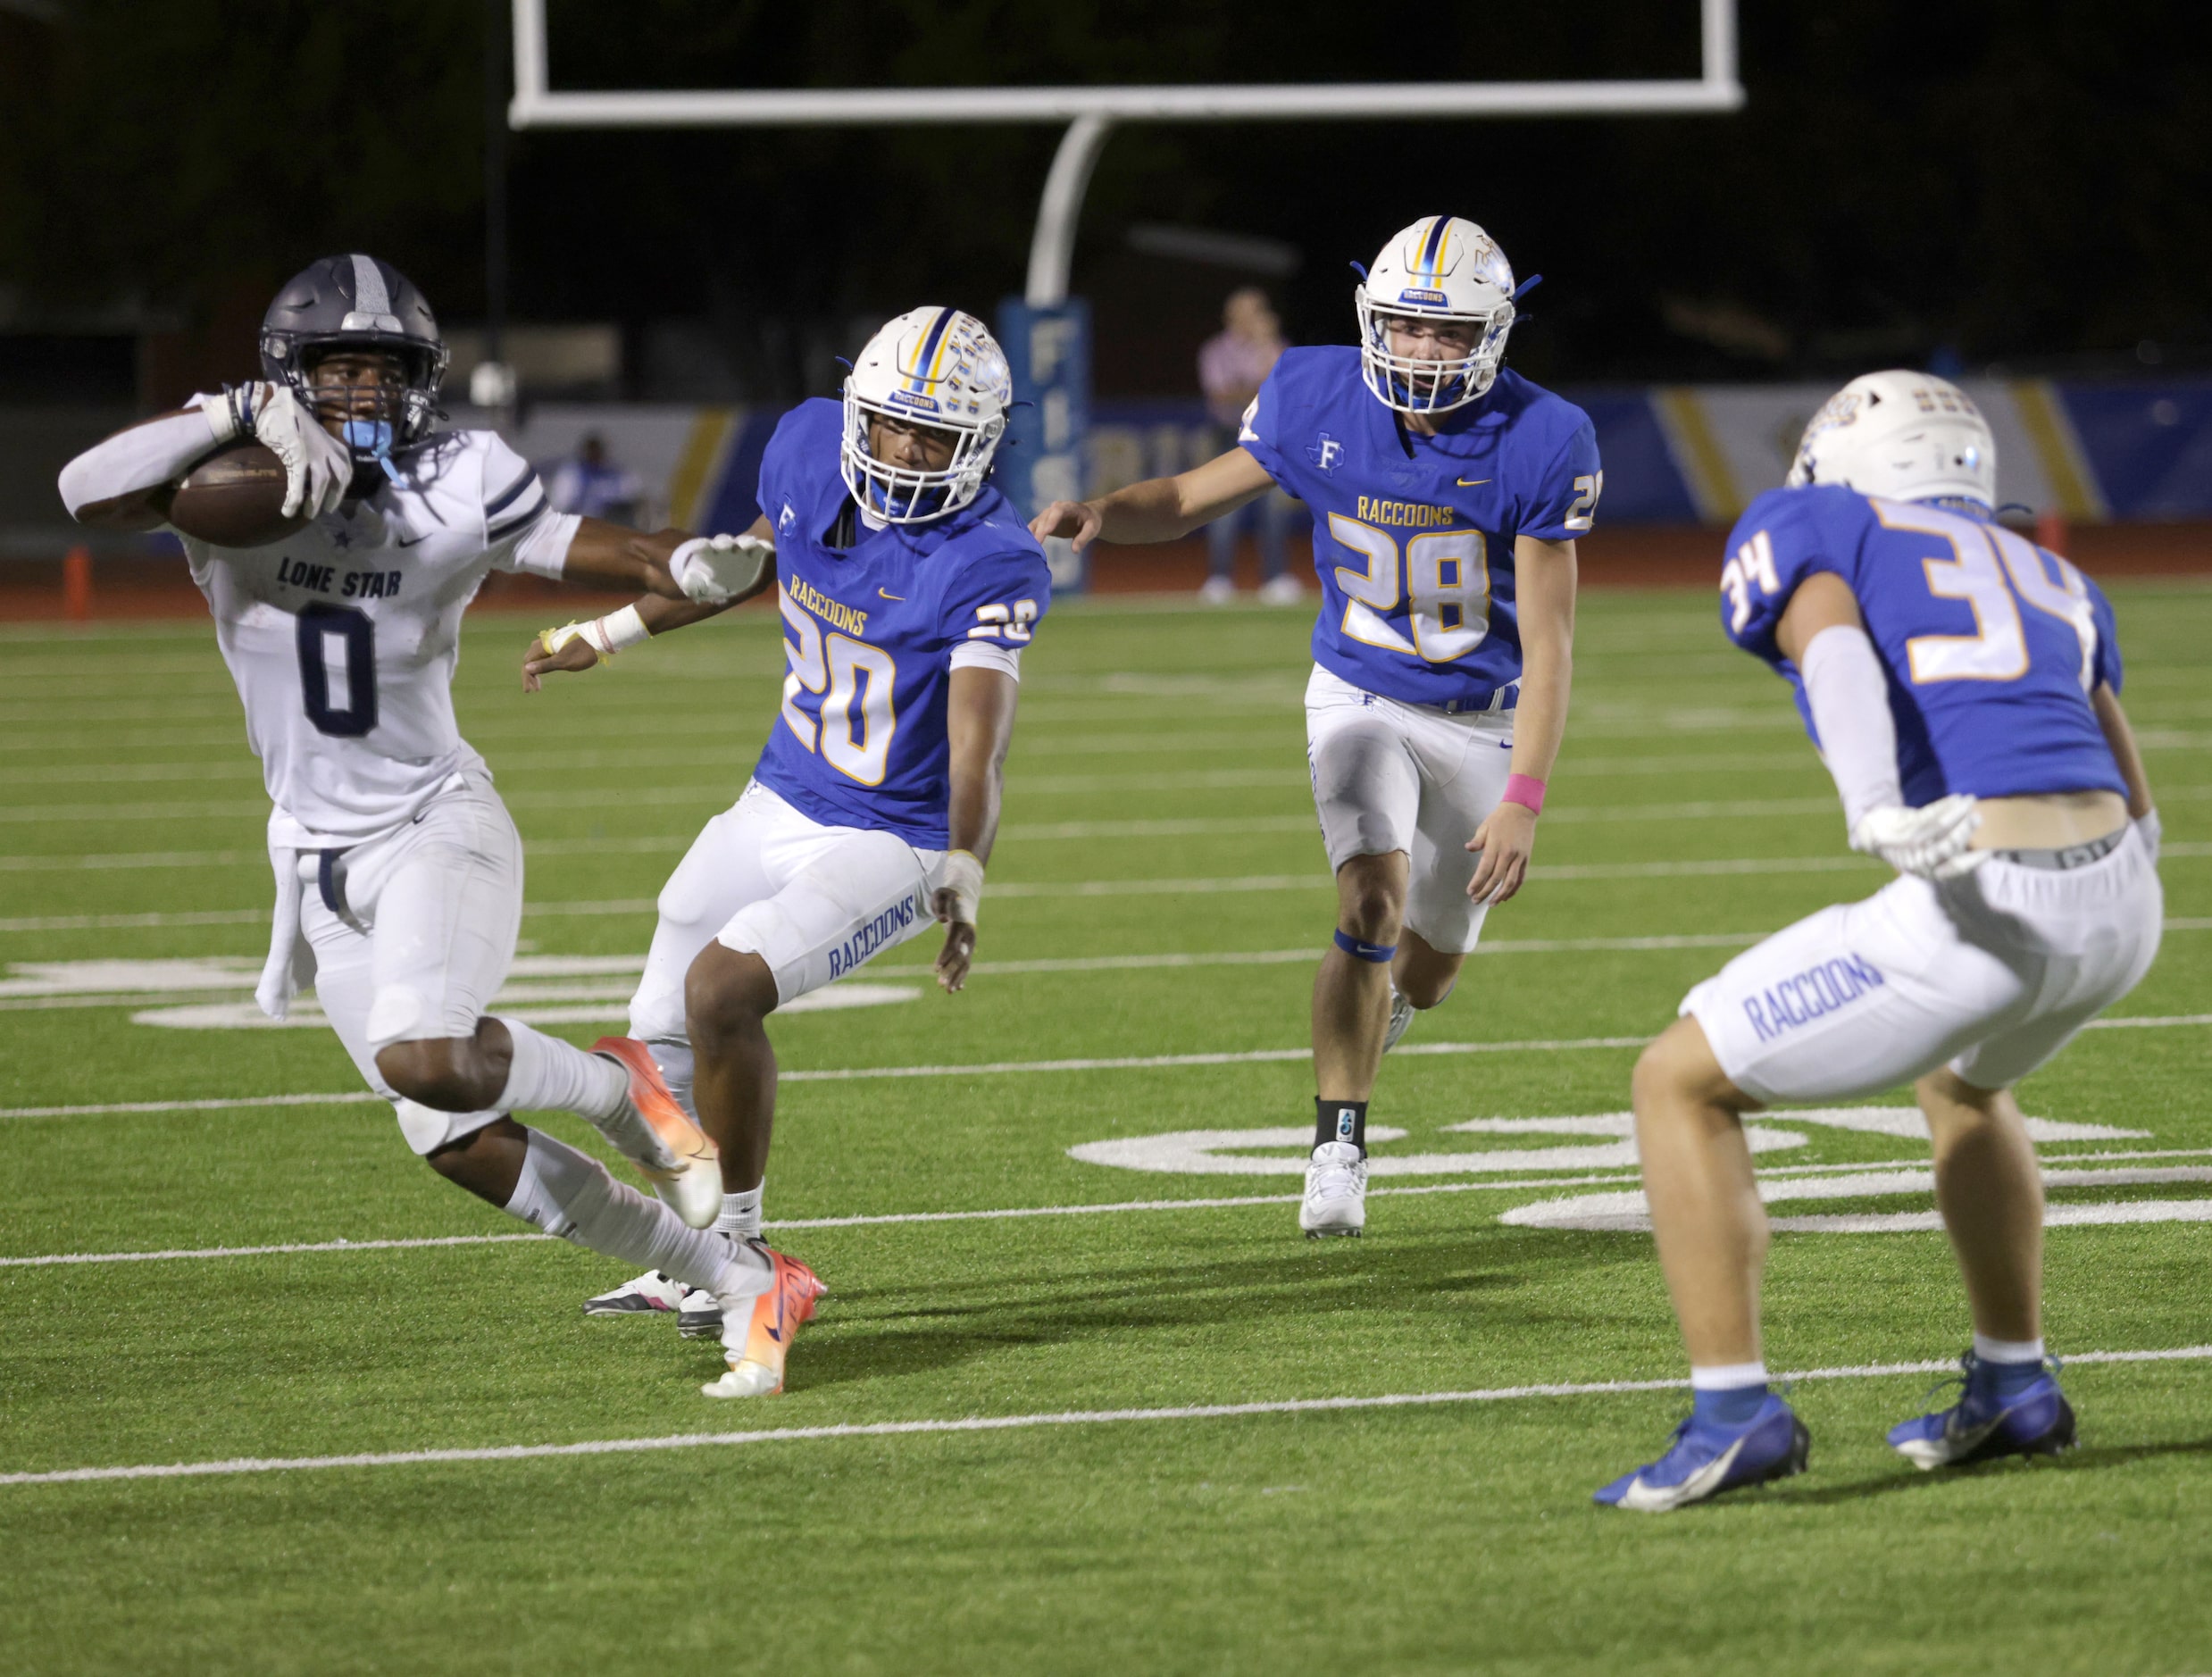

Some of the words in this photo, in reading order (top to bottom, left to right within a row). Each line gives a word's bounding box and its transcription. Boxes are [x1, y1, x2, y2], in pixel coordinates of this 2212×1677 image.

[1318, 440, 1340, 469] F
[1356, 496, 1454, 528] RACCOONS
[277, 556, 336, 593] LONE
[340, 570, 403, 599] STAR
[789, 573, 868, 637] RACCOONS
[1327, 511, 1491, 663] 28
[1719, 530, 1782, 635] 34
[1867, 496, 2099, 710] 34
[296, 599, 380, 738] 0
[778, 578, 897, 787] 20
[828, 894, 914, 981] RACCOONS
